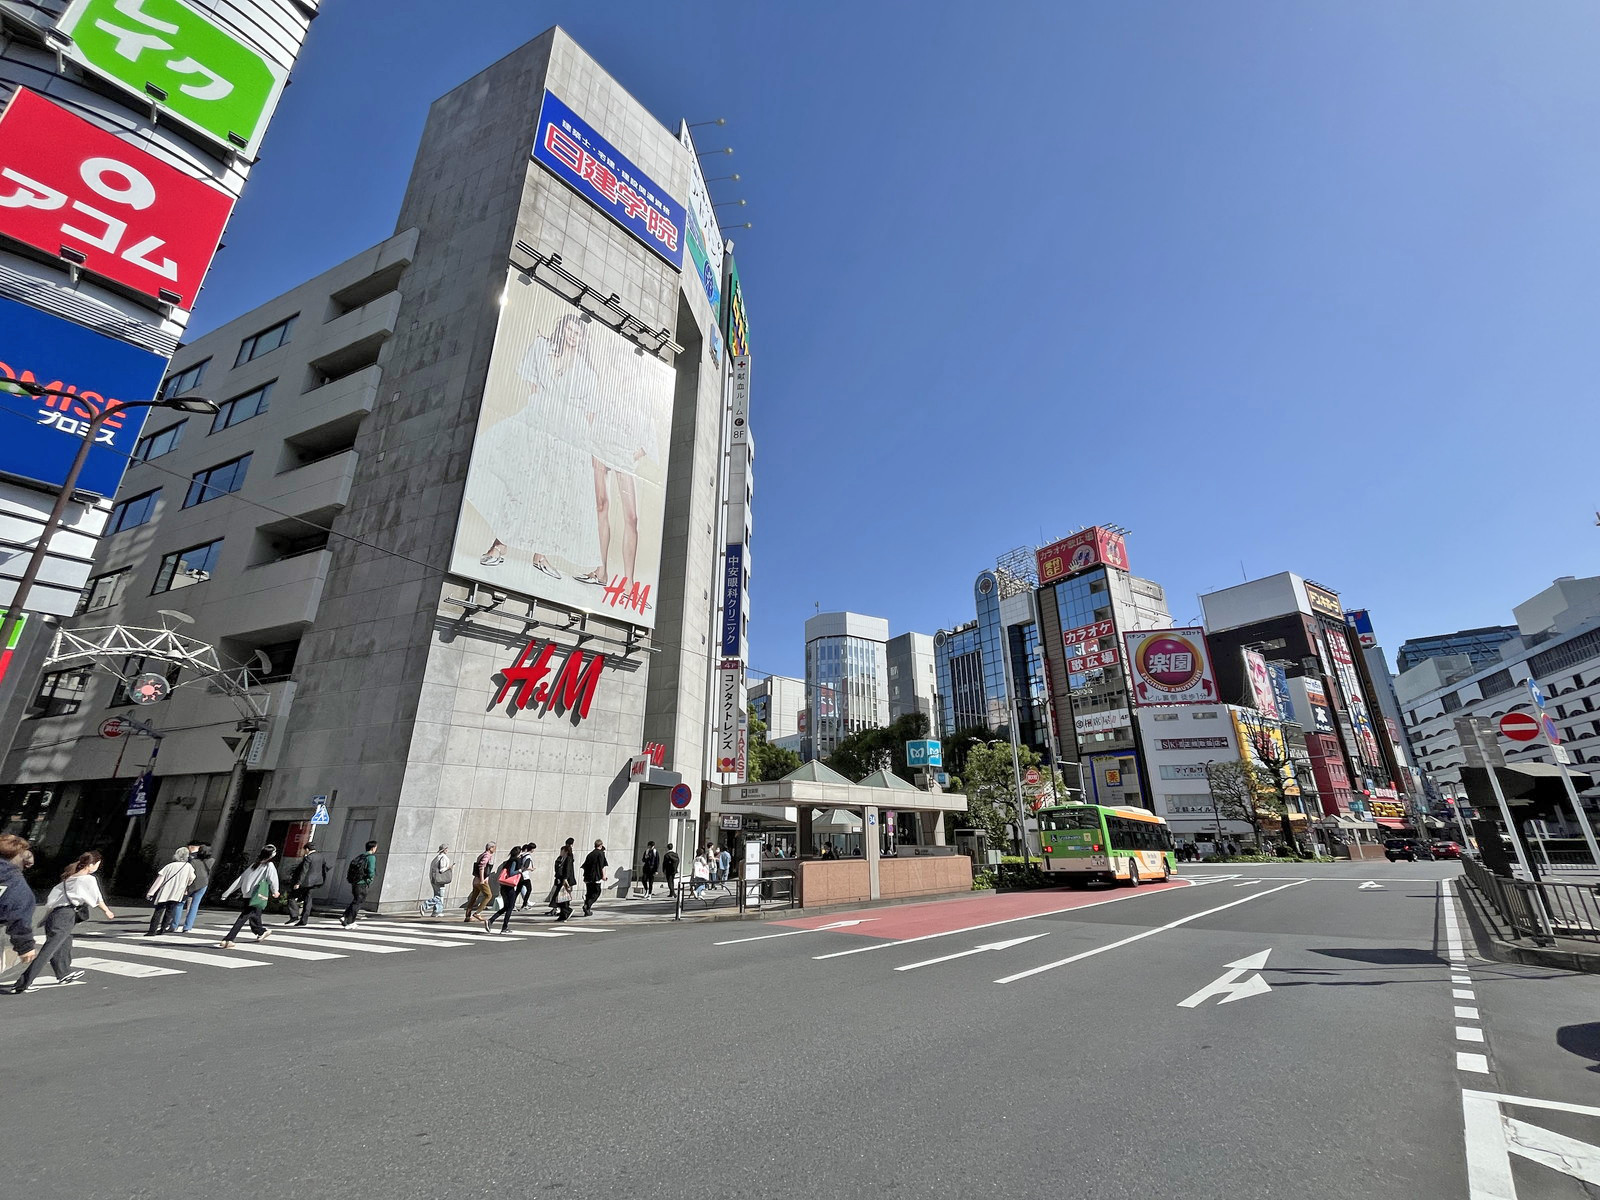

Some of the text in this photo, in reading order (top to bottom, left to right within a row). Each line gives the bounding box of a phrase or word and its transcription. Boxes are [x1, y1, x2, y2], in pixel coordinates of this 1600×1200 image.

[543, 121, 679, 252] 日建学院
[0, 167, 178, 283] アコム
[735, 372, 746, 416] 献血ルーム
[733, 430, 745, 439] 8F
[601, 574, 651, 616] H&M
[726, 555, 739, 645] 中安眼科クリニック
[1066, 622, 1111, 644] カラオケ
[495, 639, 605, 720] H&M
[1071, 651, 1114, 671] 歌広場
[1148, 652, 1192, 674] 楽園
[722, 674, 734, 750] コンタクトレンズ
[736, 728, 746, 779] TAKASE
